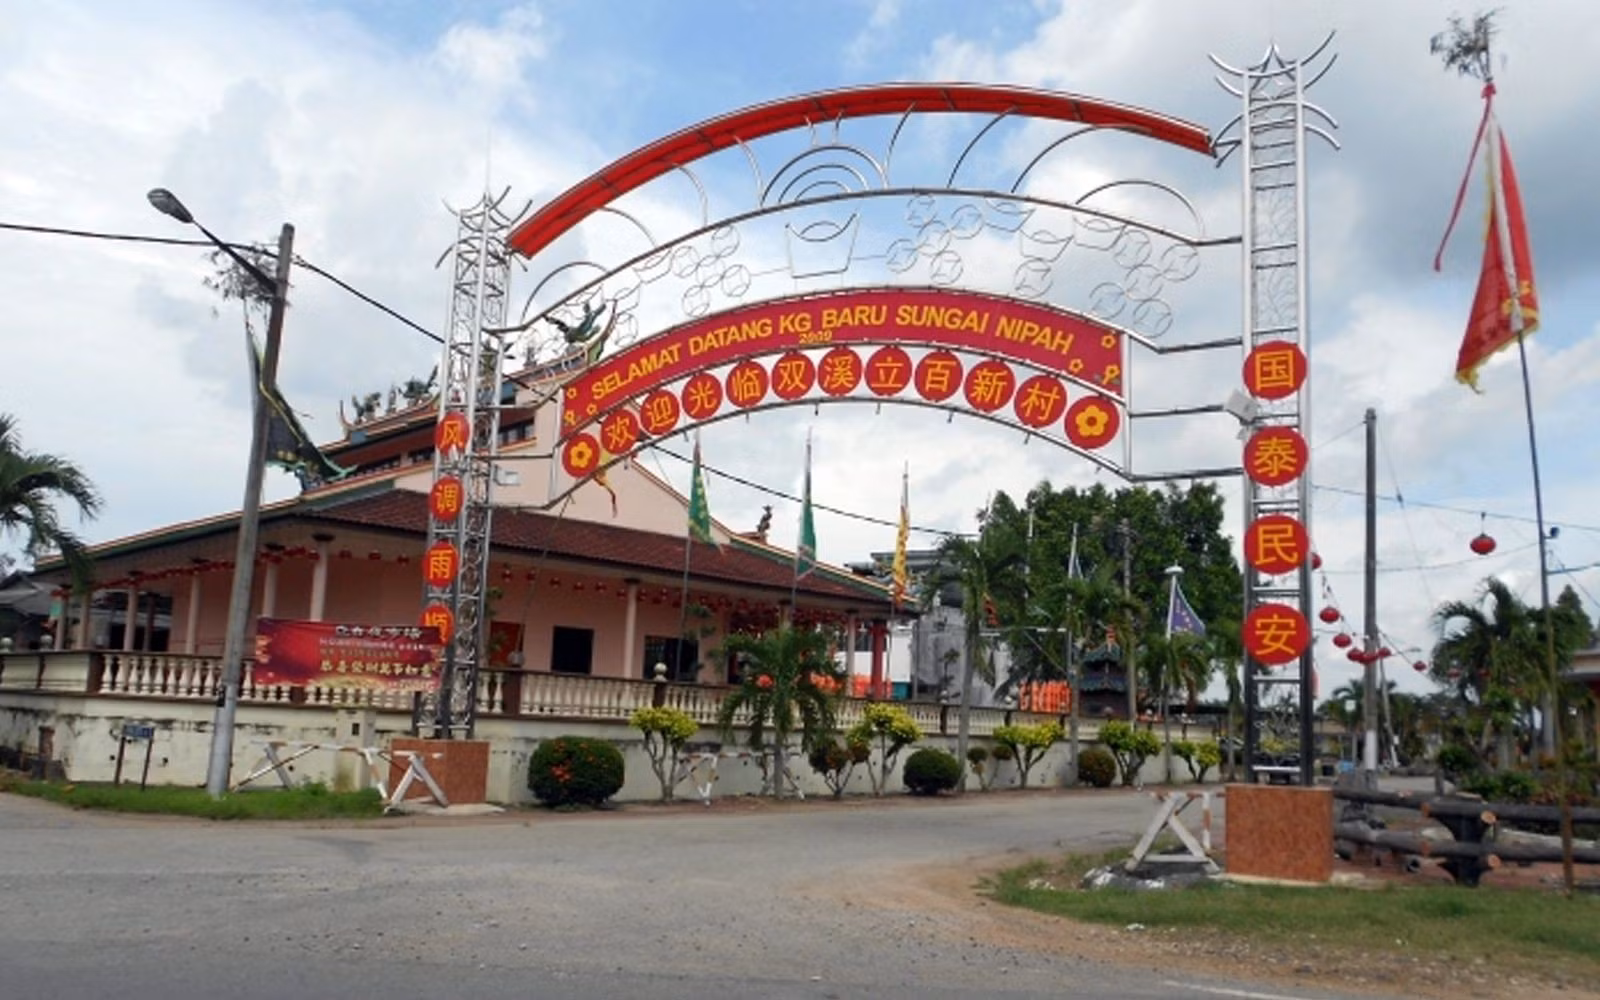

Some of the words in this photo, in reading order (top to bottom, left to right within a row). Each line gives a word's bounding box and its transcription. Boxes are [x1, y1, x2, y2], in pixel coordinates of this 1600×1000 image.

[591, 343, 683, 400] SELAMAT
[688, 317, 773, 356] DATANG
[778, 313, 812, 335] KG
[822, 305, 887, 329] BARU
[895, 305, 990, 333] SUNGAI
[995, 316, 1075, 355] NIPAH
[605, 355, 1061, 449] 欢迎光临双溪立百新村
[424, 420, 463, 644] 风调雨顺
[1254, 350, 1299, 655] 国泰民安
